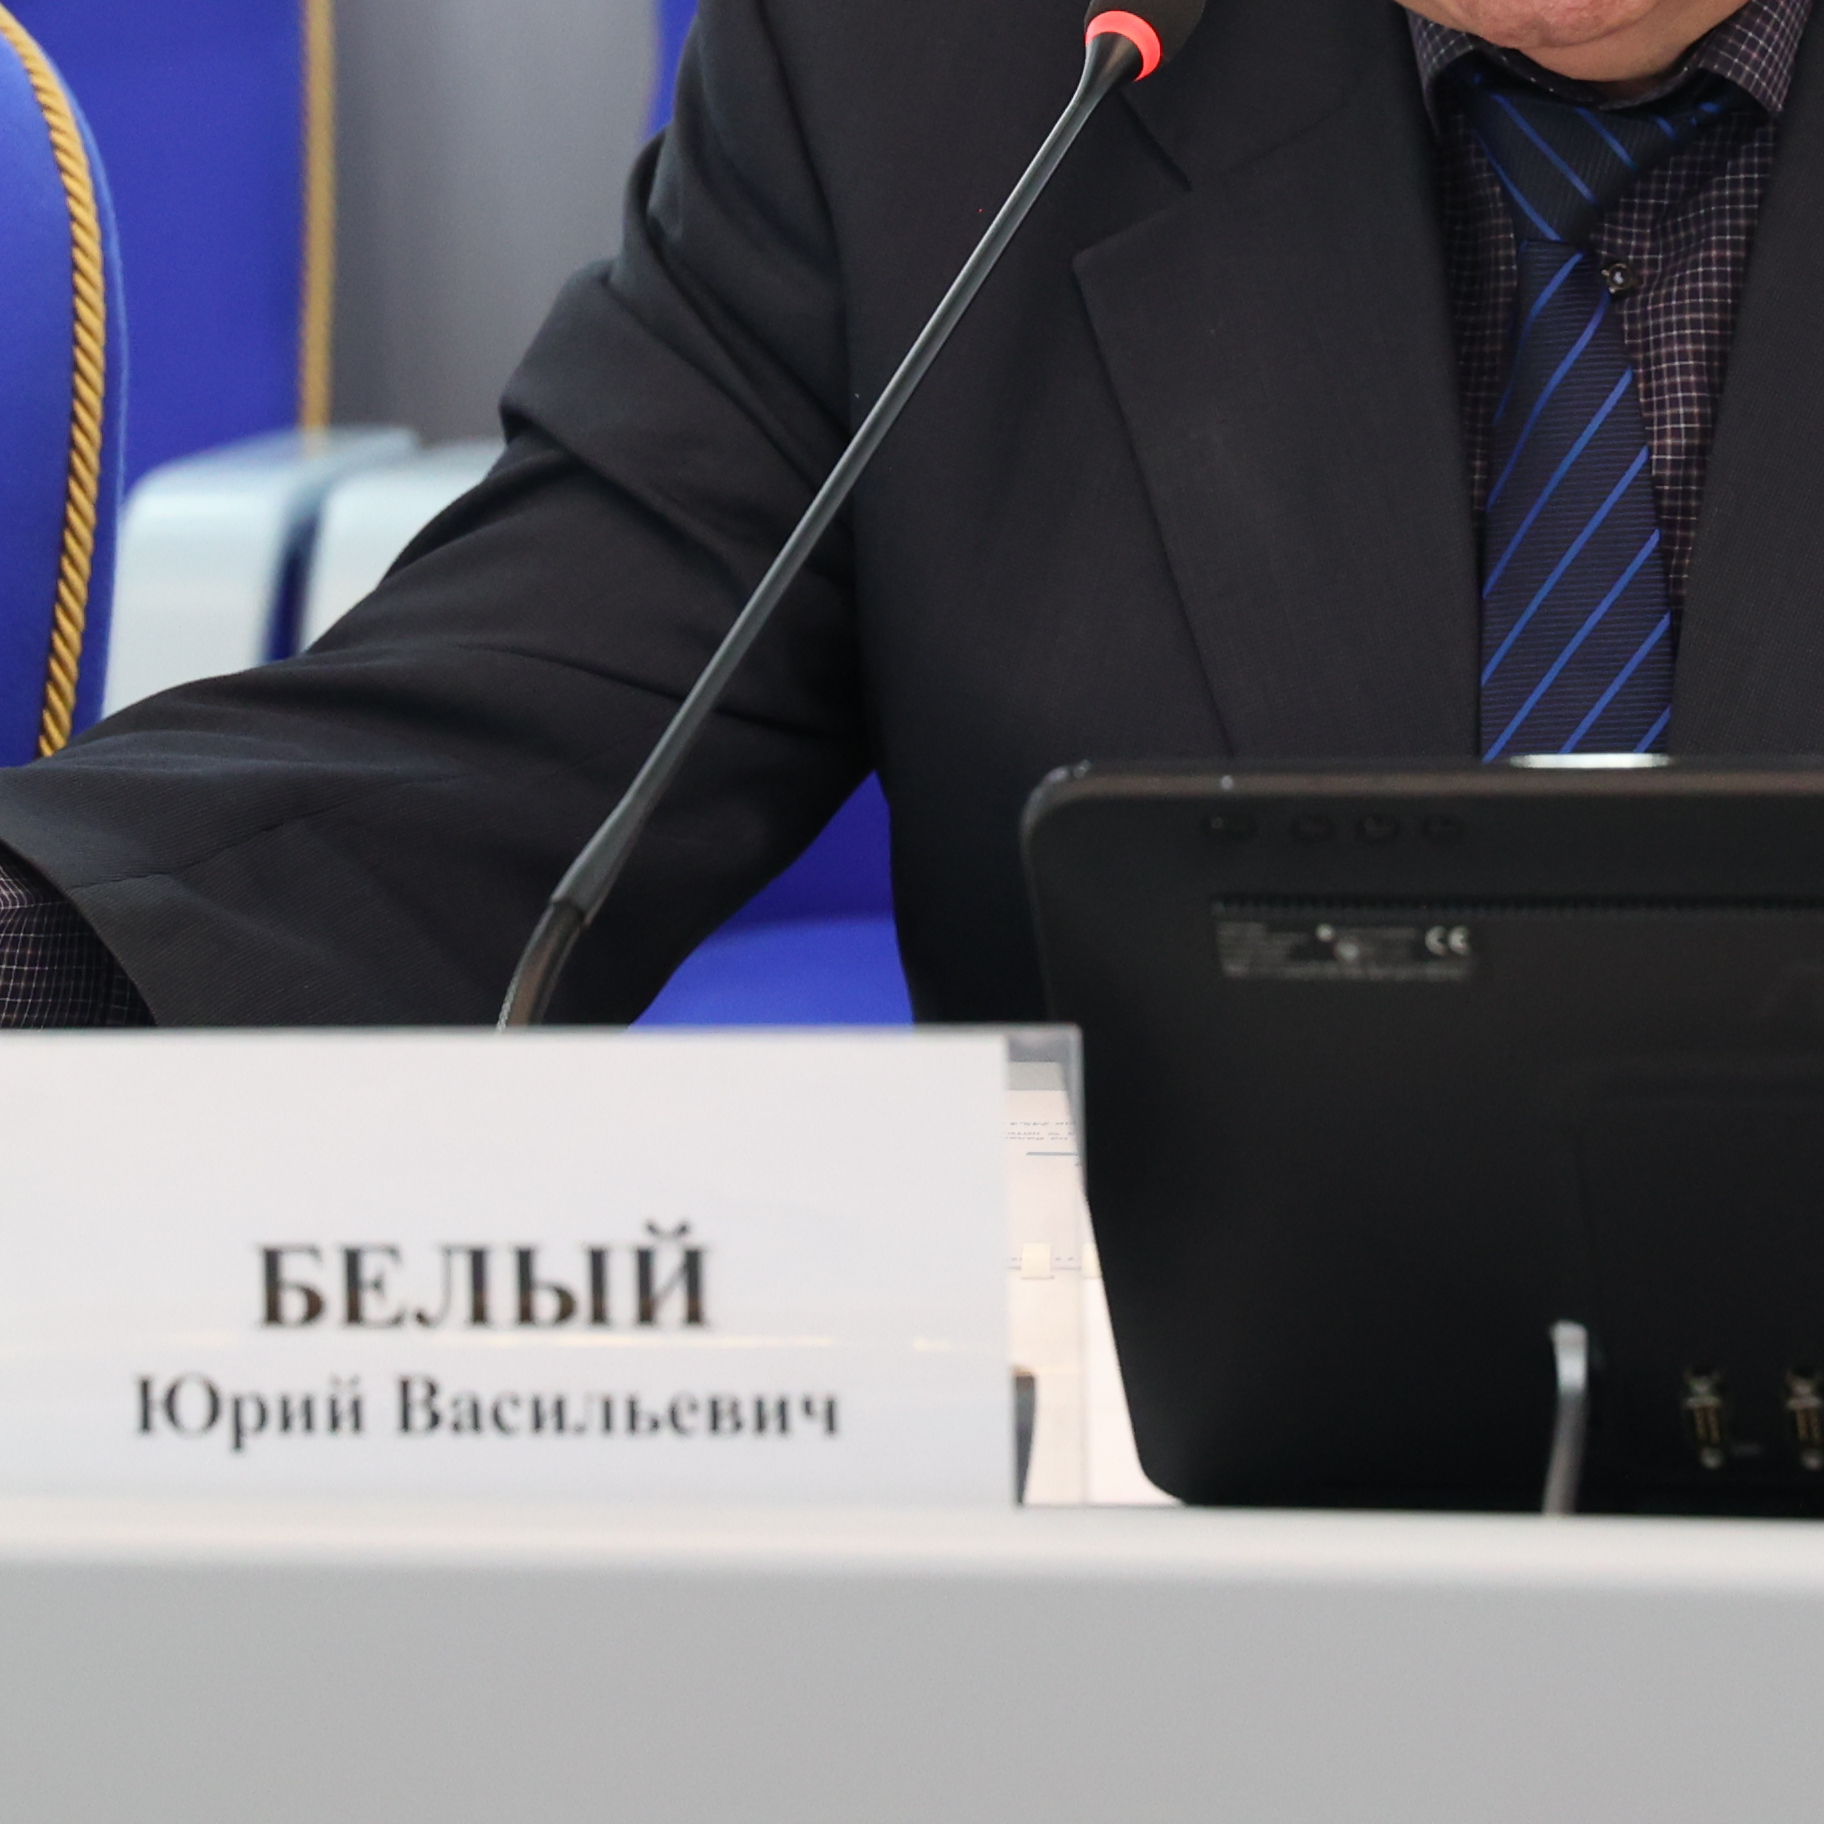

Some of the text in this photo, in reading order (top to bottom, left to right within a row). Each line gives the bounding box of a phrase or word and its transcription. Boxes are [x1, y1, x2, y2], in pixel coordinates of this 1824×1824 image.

[259, 1219, 709, 1328] БЕЛЫЙ
[136, 1375, 841, 1453] Юрий Васильевич
